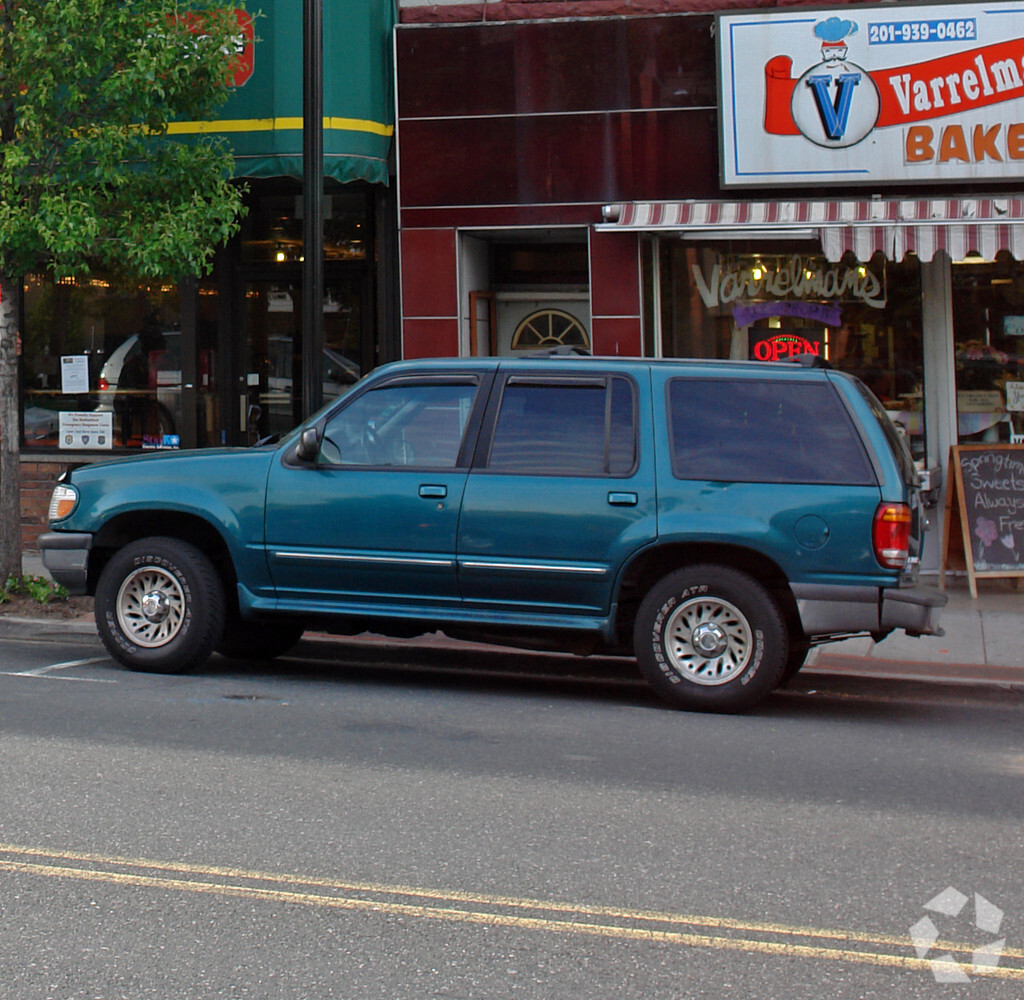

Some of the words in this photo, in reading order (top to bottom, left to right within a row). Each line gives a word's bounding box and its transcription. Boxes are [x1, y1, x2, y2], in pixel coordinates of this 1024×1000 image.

[869, 20, 975, 42] 201-939-0462
[754, 340, 820, 361] OPEN
[974, 492, 1024, 514] Always
